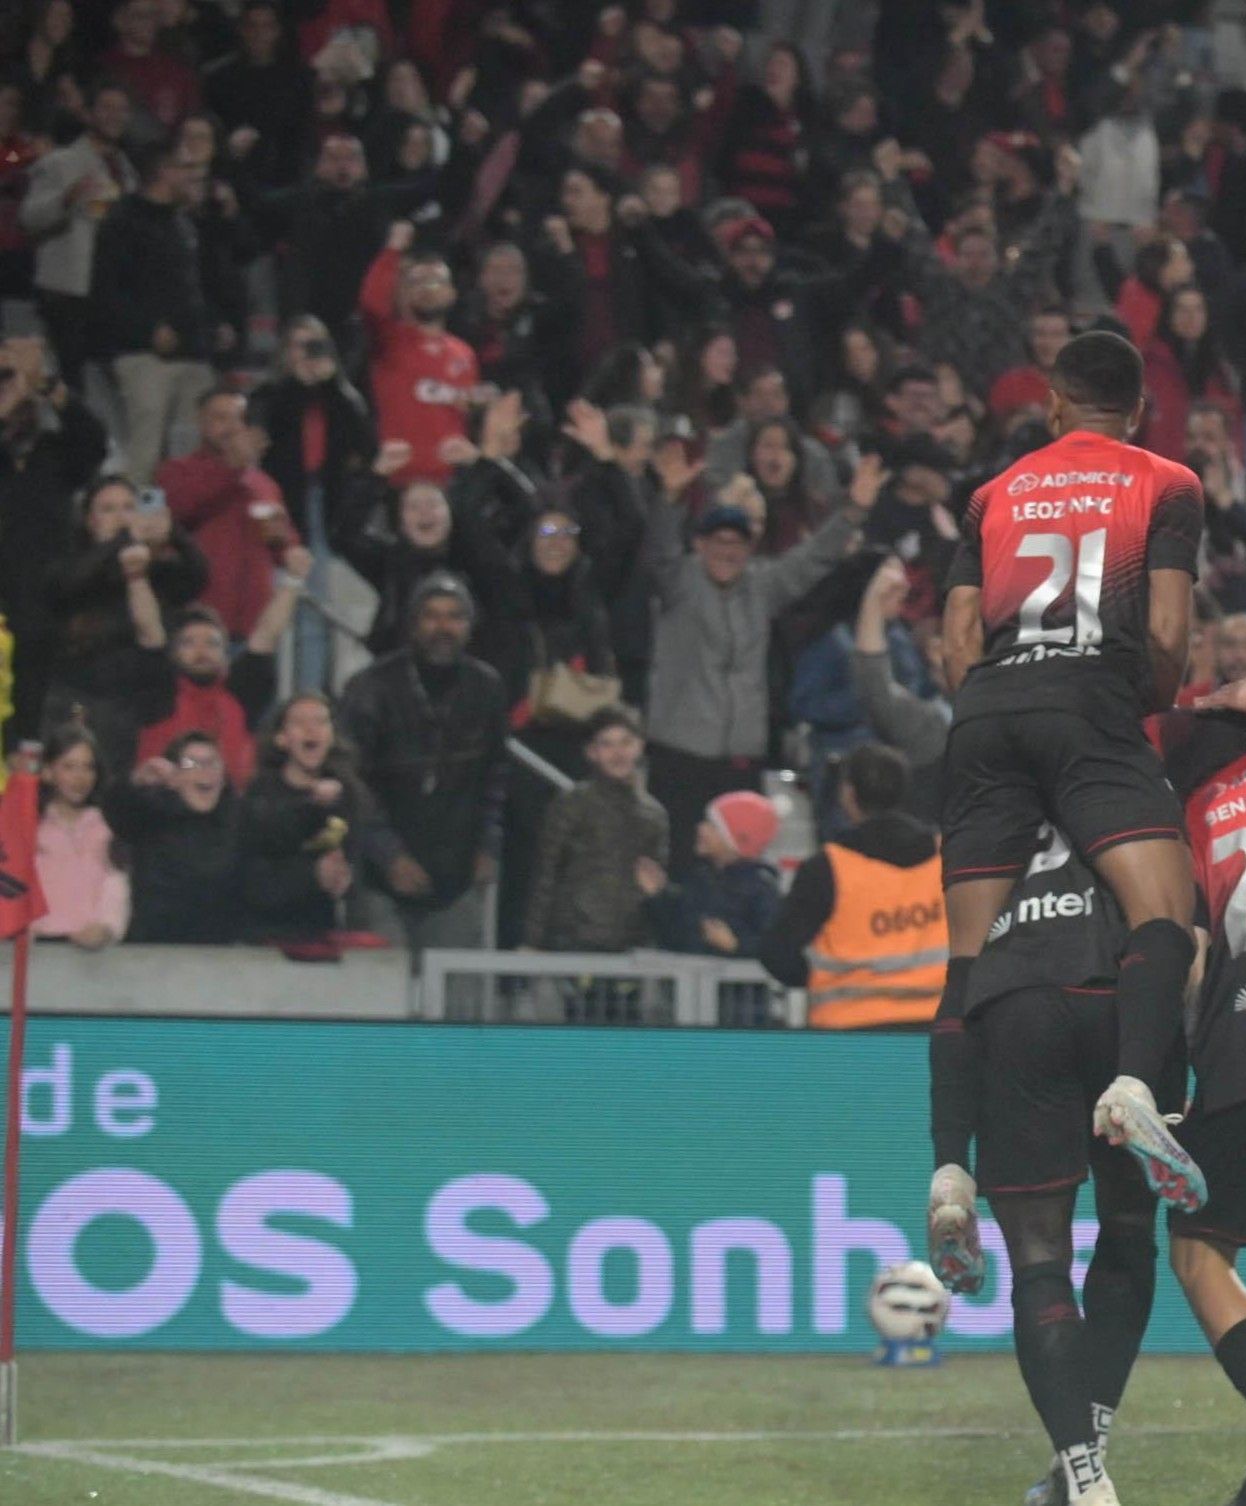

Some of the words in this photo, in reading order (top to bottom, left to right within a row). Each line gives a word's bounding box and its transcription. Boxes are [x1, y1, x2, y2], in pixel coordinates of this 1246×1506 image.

[1012, 495, 1113, 521] LEOZNHO
[1015, 528, 1106, 646] 21
[1012, 886, 1096, 928] nter
[20, 1043, 158, 1138] de
[0, 1166, 360, 1339] OS
[424, 1172, 1100, 1339] Sonho
